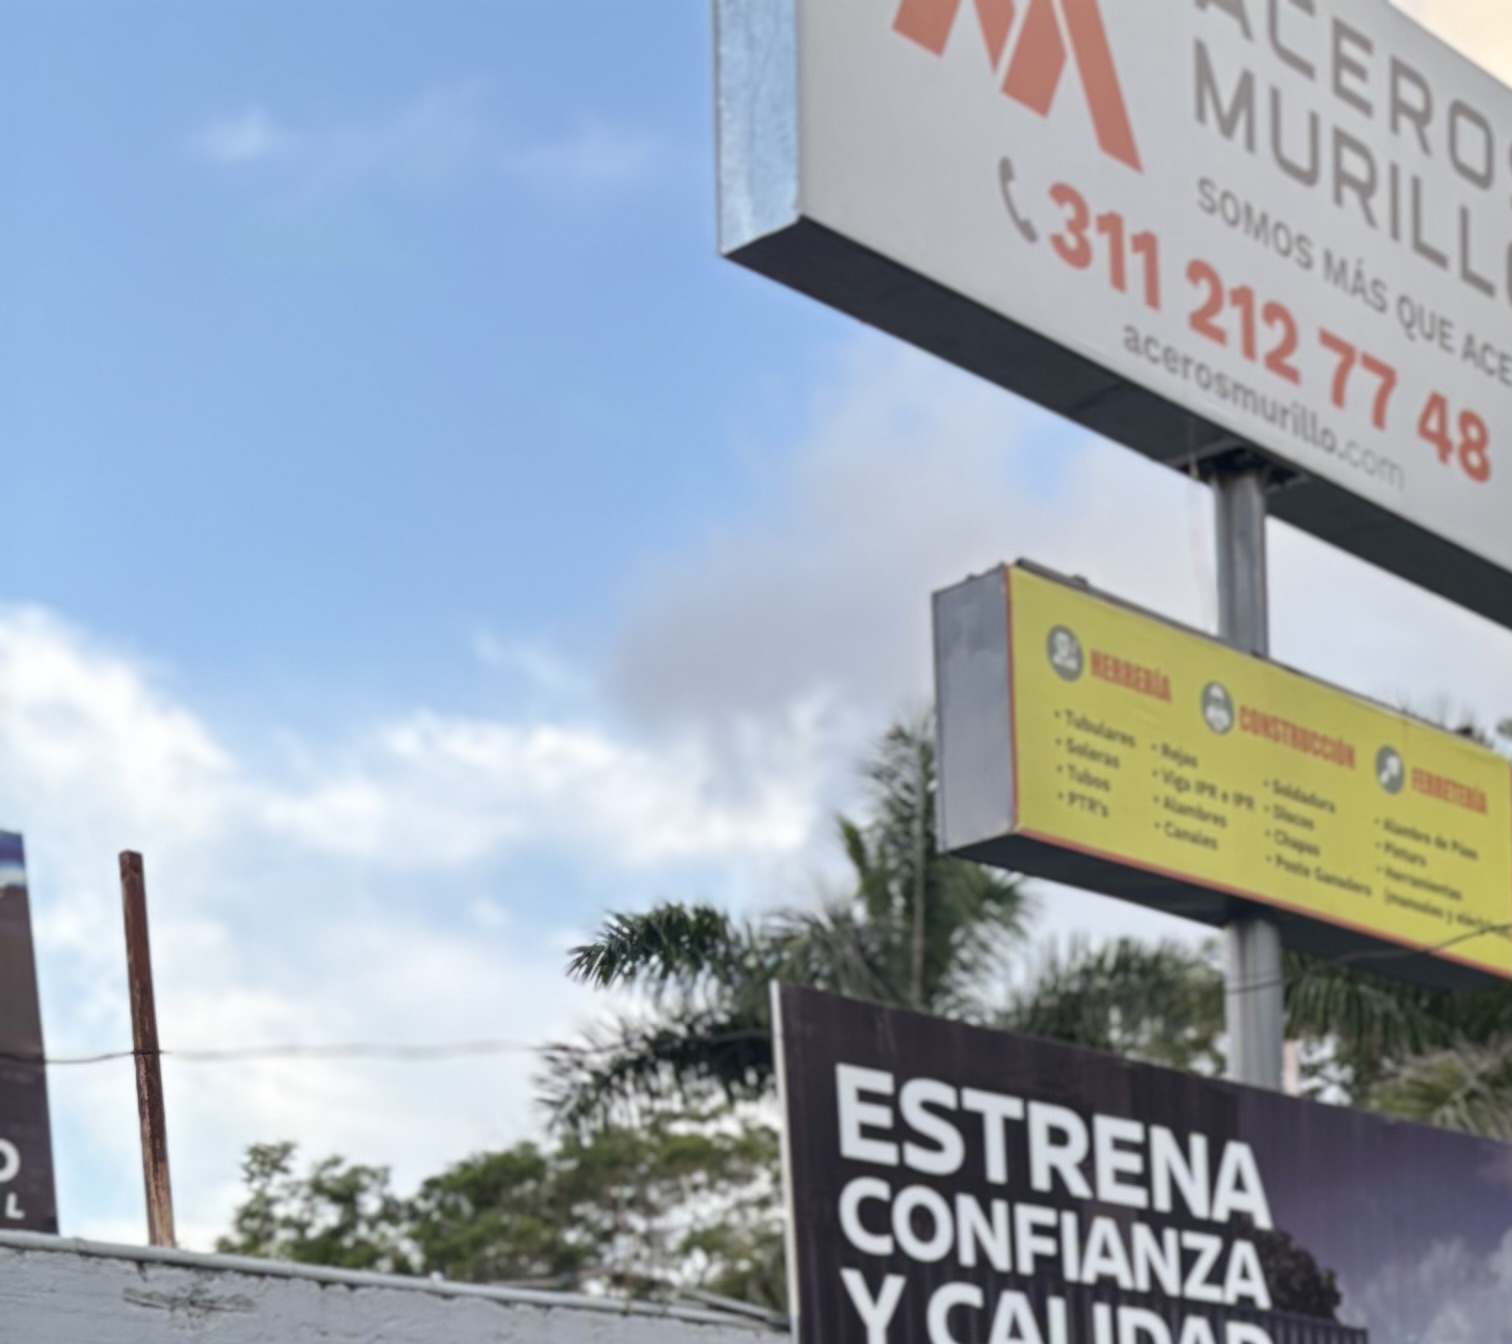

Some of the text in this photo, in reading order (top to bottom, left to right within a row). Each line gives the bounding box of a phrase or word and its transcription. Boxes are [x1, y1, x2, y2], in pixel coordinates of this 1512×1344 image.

[1048, 181, 1491, 483] 311 212 77 48
[1197, 177, 1314, 271] SOMOS
[1323, 248, 1388, 313] MÁS
[1395, 293, 1453, 353] QUE
[1122, 323, 1403, 491] acerosmurillo.com
[836, 1062, 1273, 1232] ESTRENA
[838, 1176, 1272, 1310] CONFIANZA
